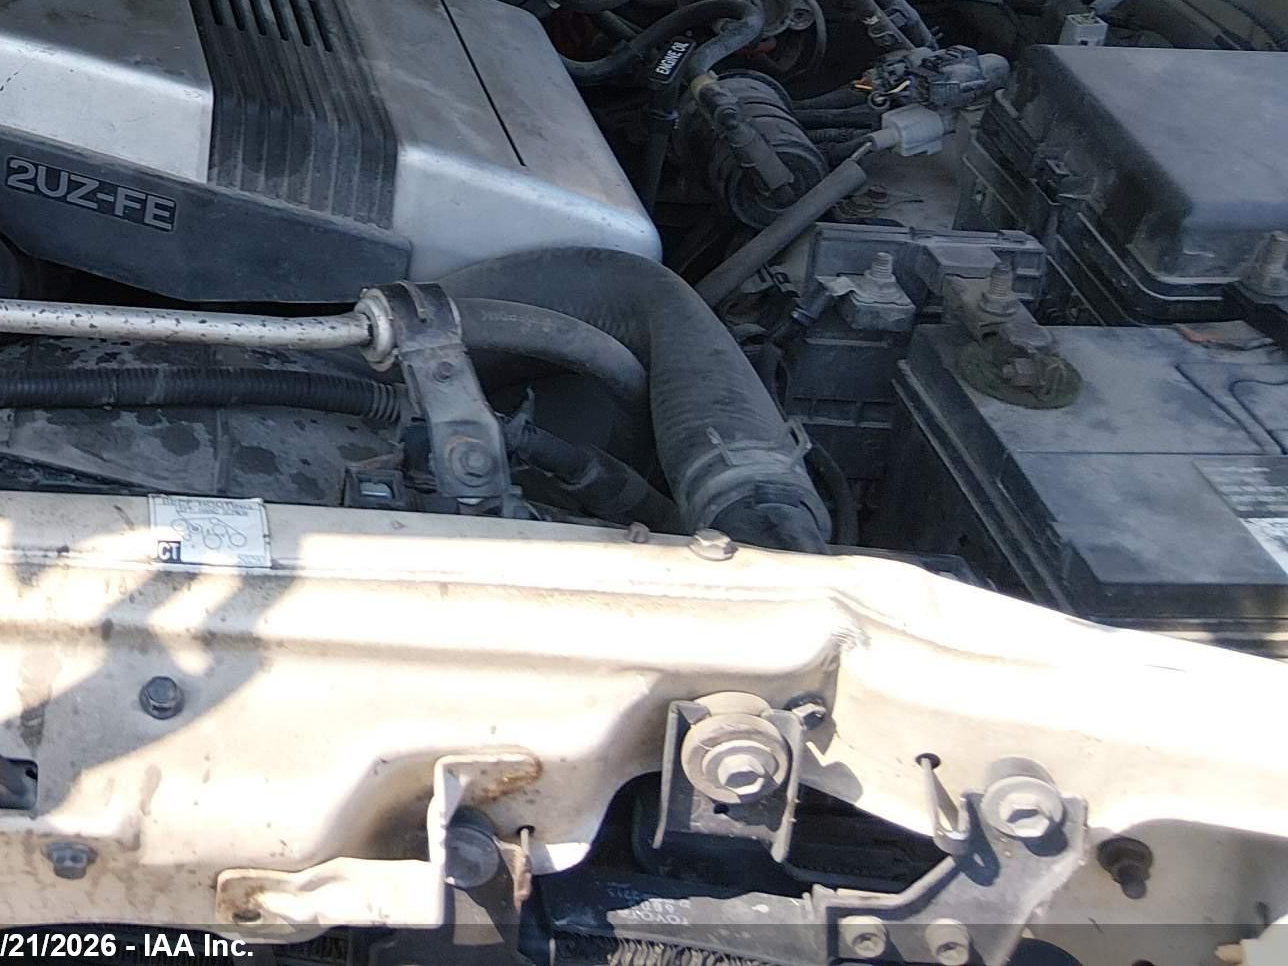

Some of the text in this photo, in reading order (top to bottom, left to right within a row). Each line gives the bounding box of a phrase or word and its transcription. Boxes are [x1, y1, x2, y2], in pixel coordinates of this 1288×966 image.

[655, 41, 690, 75] ENGINE OIL
[6, 157, 175, 231] 2UZ-FE
[158, 542, 181, 561] CT
